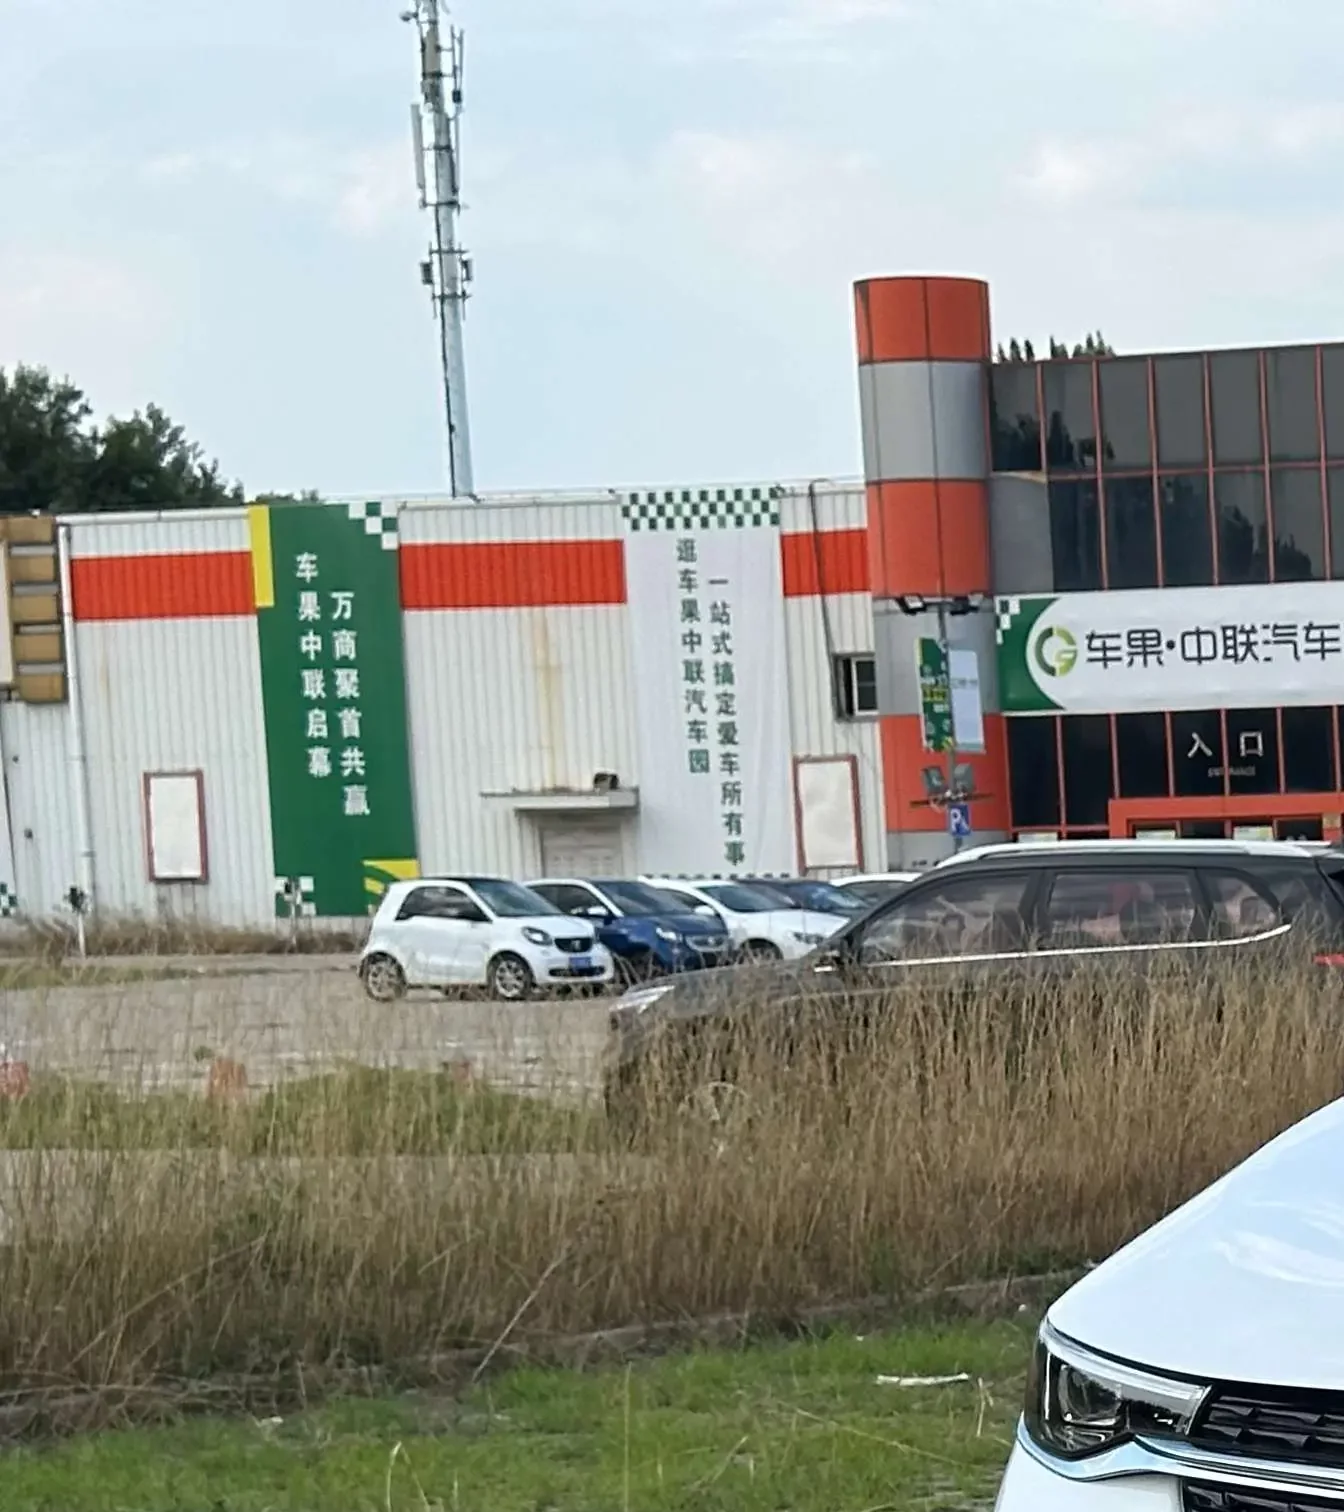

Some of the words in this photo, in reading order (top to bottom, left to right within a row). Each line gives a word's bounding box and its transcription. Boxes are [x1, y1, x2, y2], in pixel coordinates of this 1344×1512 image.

[295, 551, 332, 778] 车果中联启幕
[330, 591, 370, 817] 万商聚首共赢
[676, 537, 711, 775] 逛车果中联汽车园
[708, 577, 745, 867] 一站式搞定爱车所有事
[1187, 731, 1264, 758] 入口
